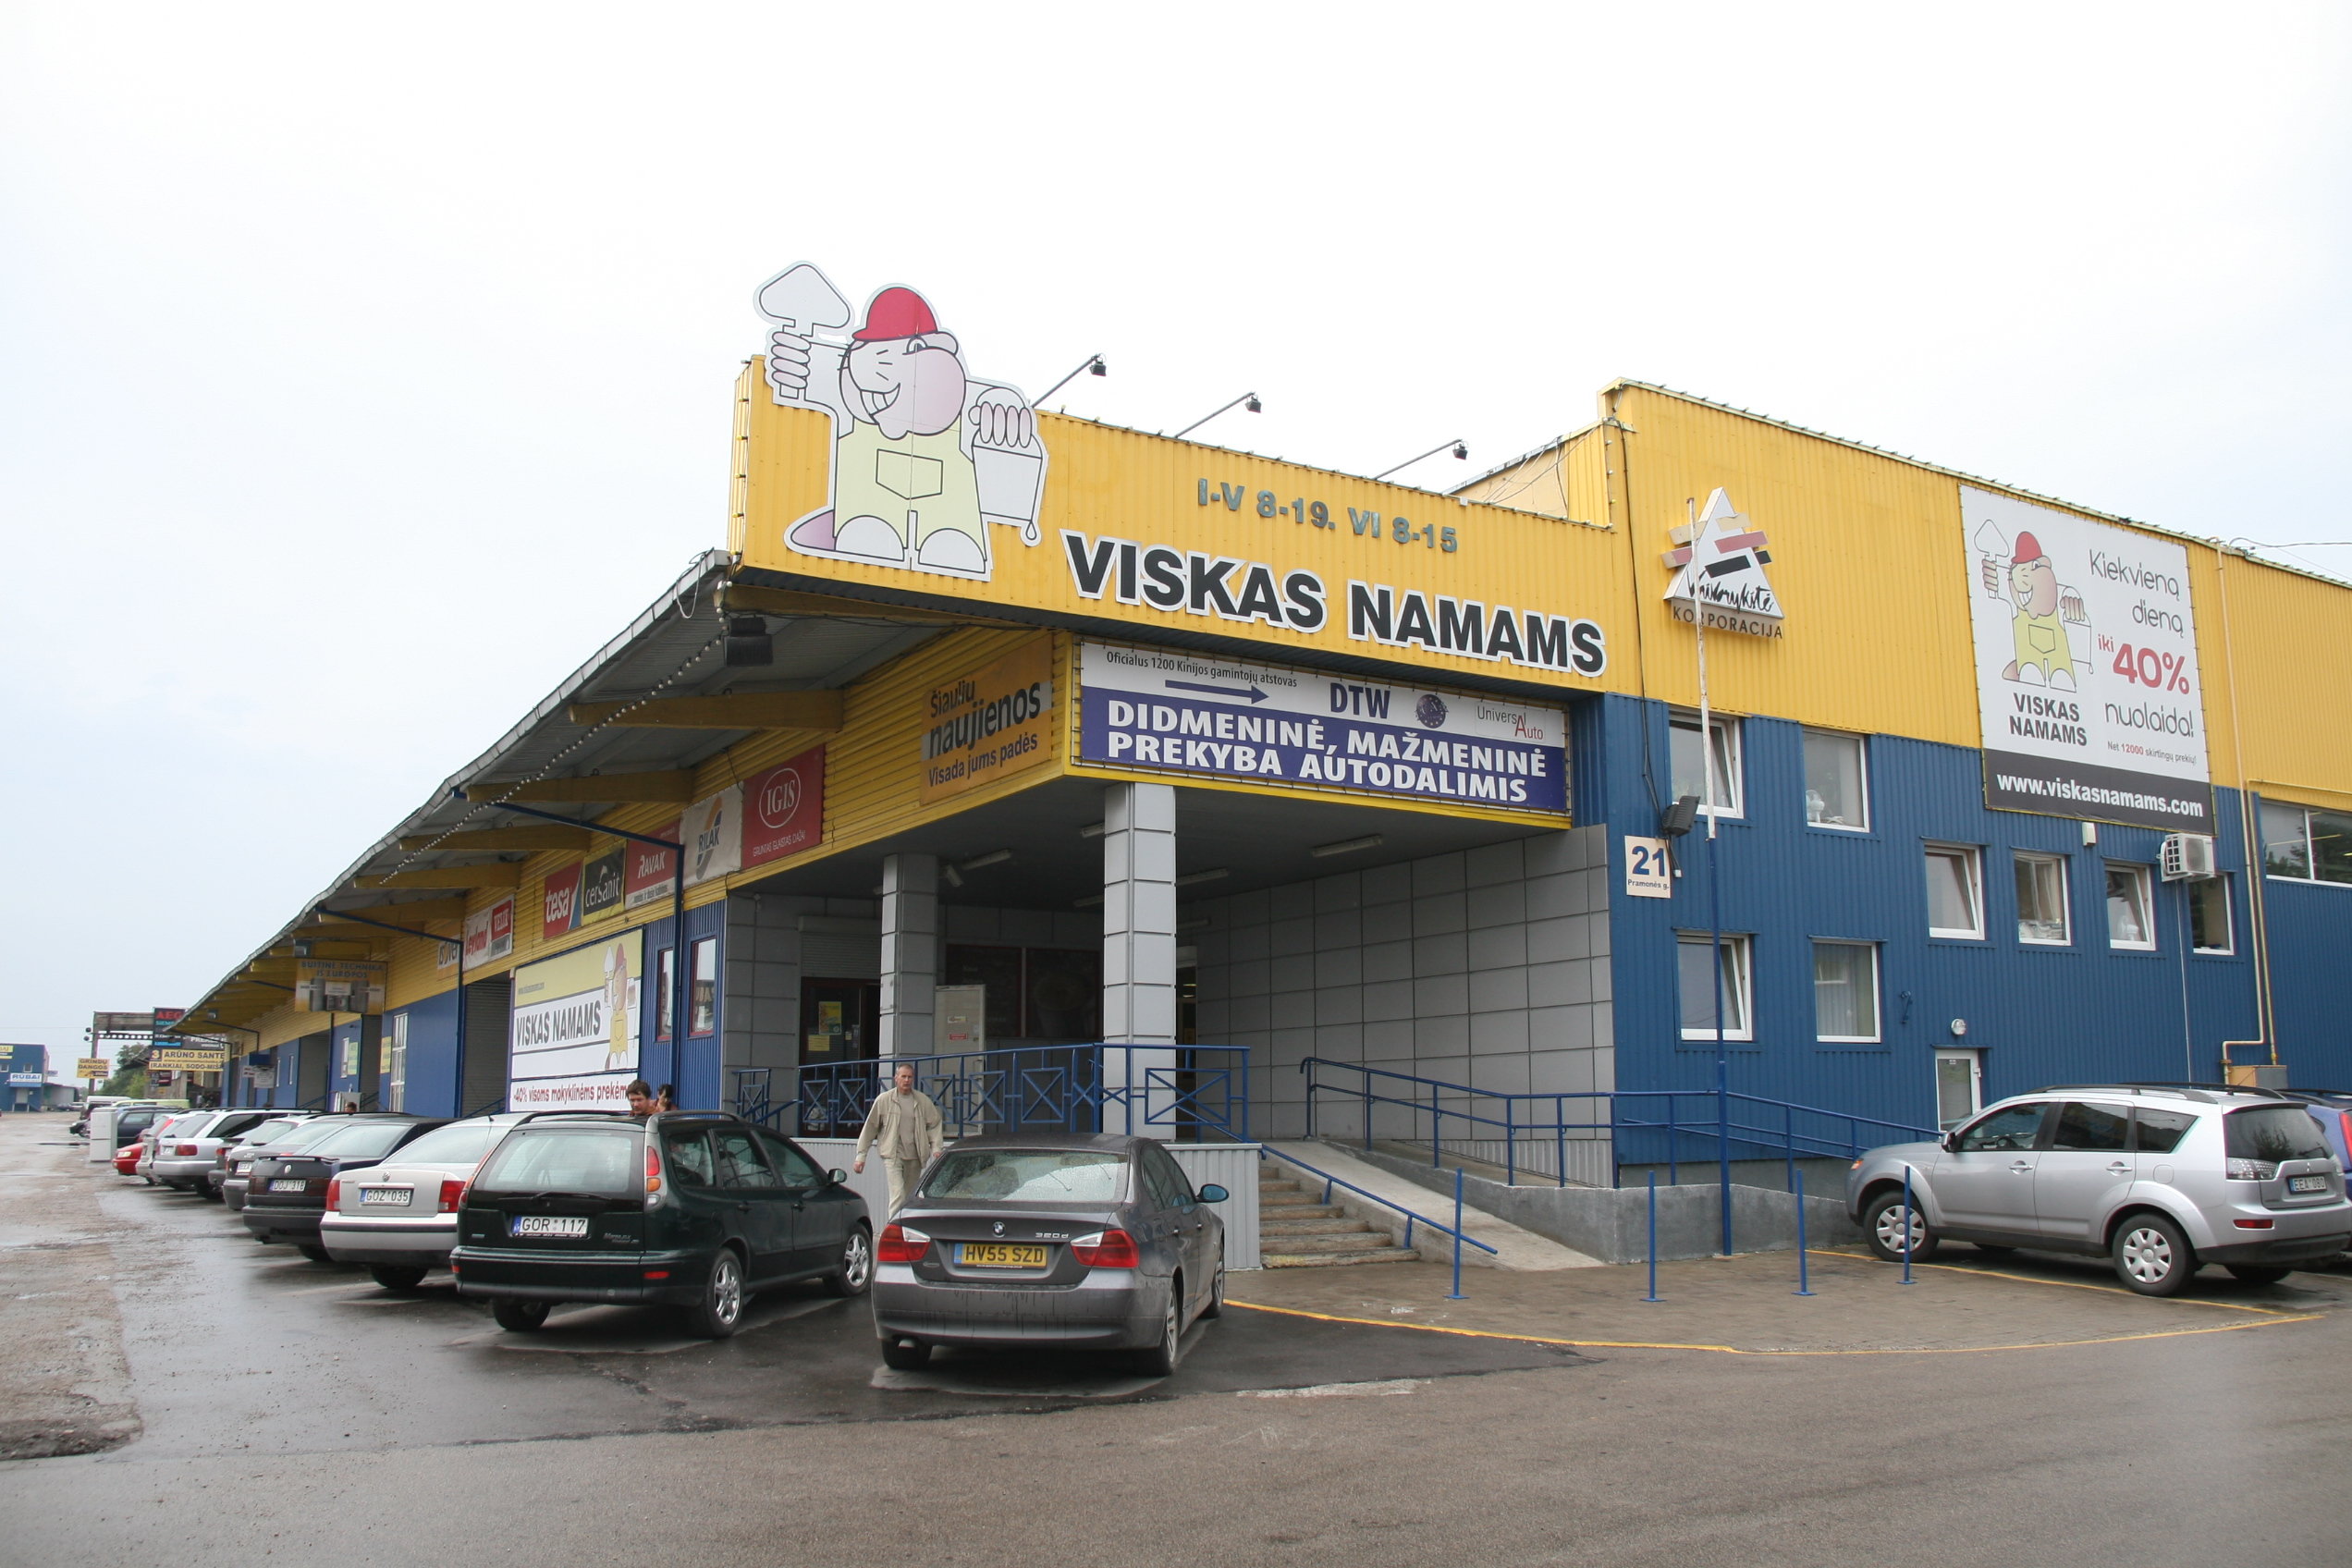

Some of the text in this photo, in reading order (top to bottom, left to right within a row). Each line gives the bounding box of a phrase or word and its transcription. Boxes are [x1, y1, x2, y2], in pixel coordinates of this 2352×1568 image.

[1347, 507, 1382, 539] VI
[1391, 516, 1459, 553] 8-15
[2089, 548, 2180, 601] Kiekvieną
[1063, 531, 1607, 676] VISKAS NAMAMS
[2132, 599, 2184, 639] dieną
[1106, 650, 1148, 668] Oficialus
[1150, 655, 1174, 670] 1200
[1176, 657, 1209, 677] Kinijos
[1259, 671, 1297, 688] atstovas
[2097, 633, 2190, 695] iki 40%
[1329, 681, 1391, 719] DTW
[2013, 692, 2080, 723] VISKAS
[929, 681, 1041, 760] naujienos
[1109, 699, 1547, 779] DIDMENINĖ, MAŽMENINĖ
[2009, 715, 2088, 747] NAMAMS
[2104, 701, 2195, 739] nuolaida!
[928, 731, 1038, 788] Visada jums padės
[1109, 730, 1527, 802] PREKYBA AUTODALIMIS
[2107, 741, 2119, 752] Net
[2121, 743, 2144, 755] 12000
[766, 779, 796, 816] IGIS
[1996, 774, 2204, 818] www.viskasnamams.com
[698, 827, 720, 853] RILAK
[637, 851, 667, 879] RAVAK
[1632, 845, 1666, 877] 21
[545, 887, 570, 924] tesa
[517, 999, 602, 1047] VISKAS NAMAMS
[152, 1049, 160, 1060] 3
[529, 1085, 550, 1103] visoms
[596, 1080, 629, 1105] prekėm
[366, 1190, 409, 1202] GOZ 035
[521, 1218, 550, 1231] GOR
[561, 1219, 586, 1232] 117
[965, 1245, 1044, 1263] HV55 SZD
